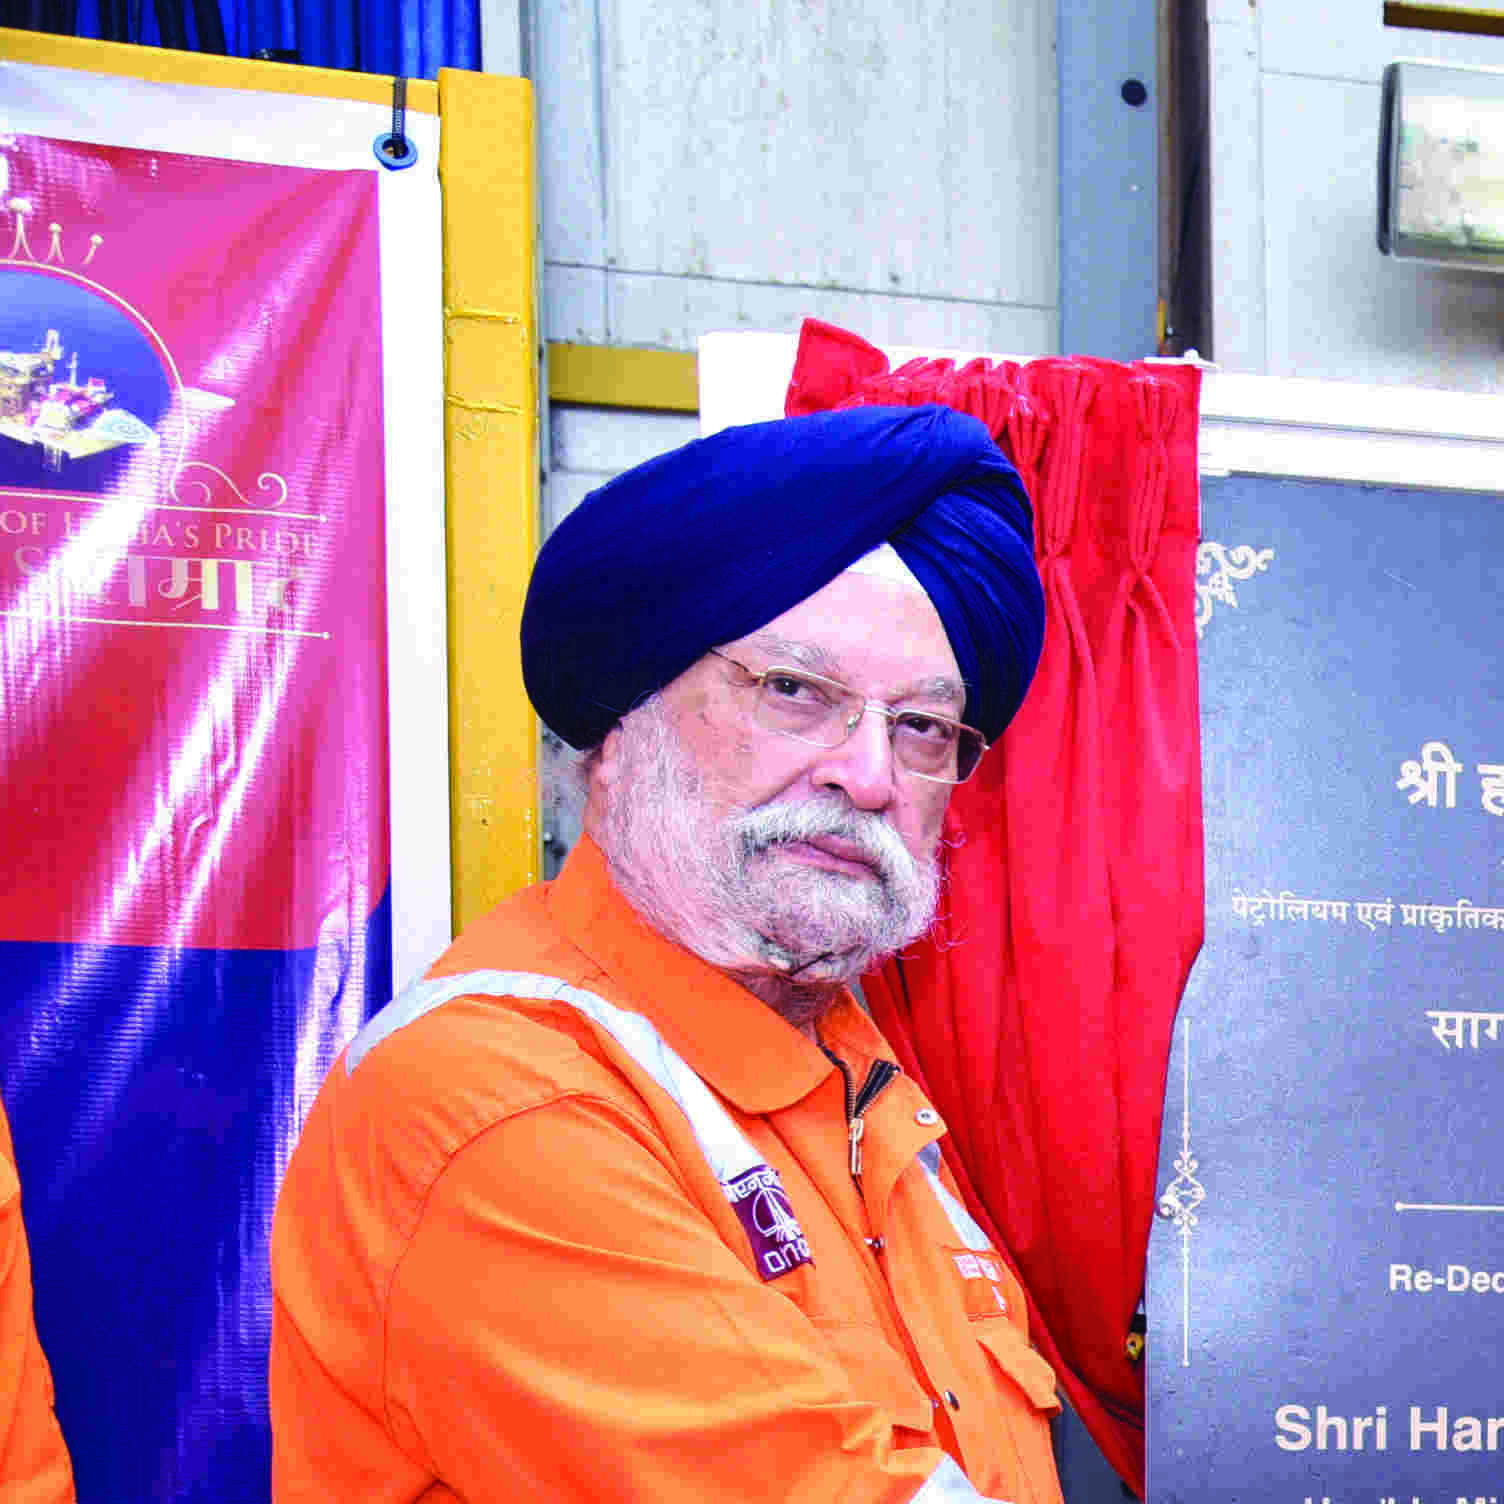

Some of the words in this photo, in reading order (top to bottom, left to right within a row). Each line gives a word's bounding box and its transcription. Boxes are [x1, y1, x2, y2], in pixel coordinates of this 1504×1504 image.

[0, 510, 48, 536] OF
[1396, 742, 1463, 809] श्री
[1231, 887, 1351, 926] पेट्रोलियम
[1354, 902, 1395, 931] एवं
[1274, 1404, 1387, 1451] Shri
